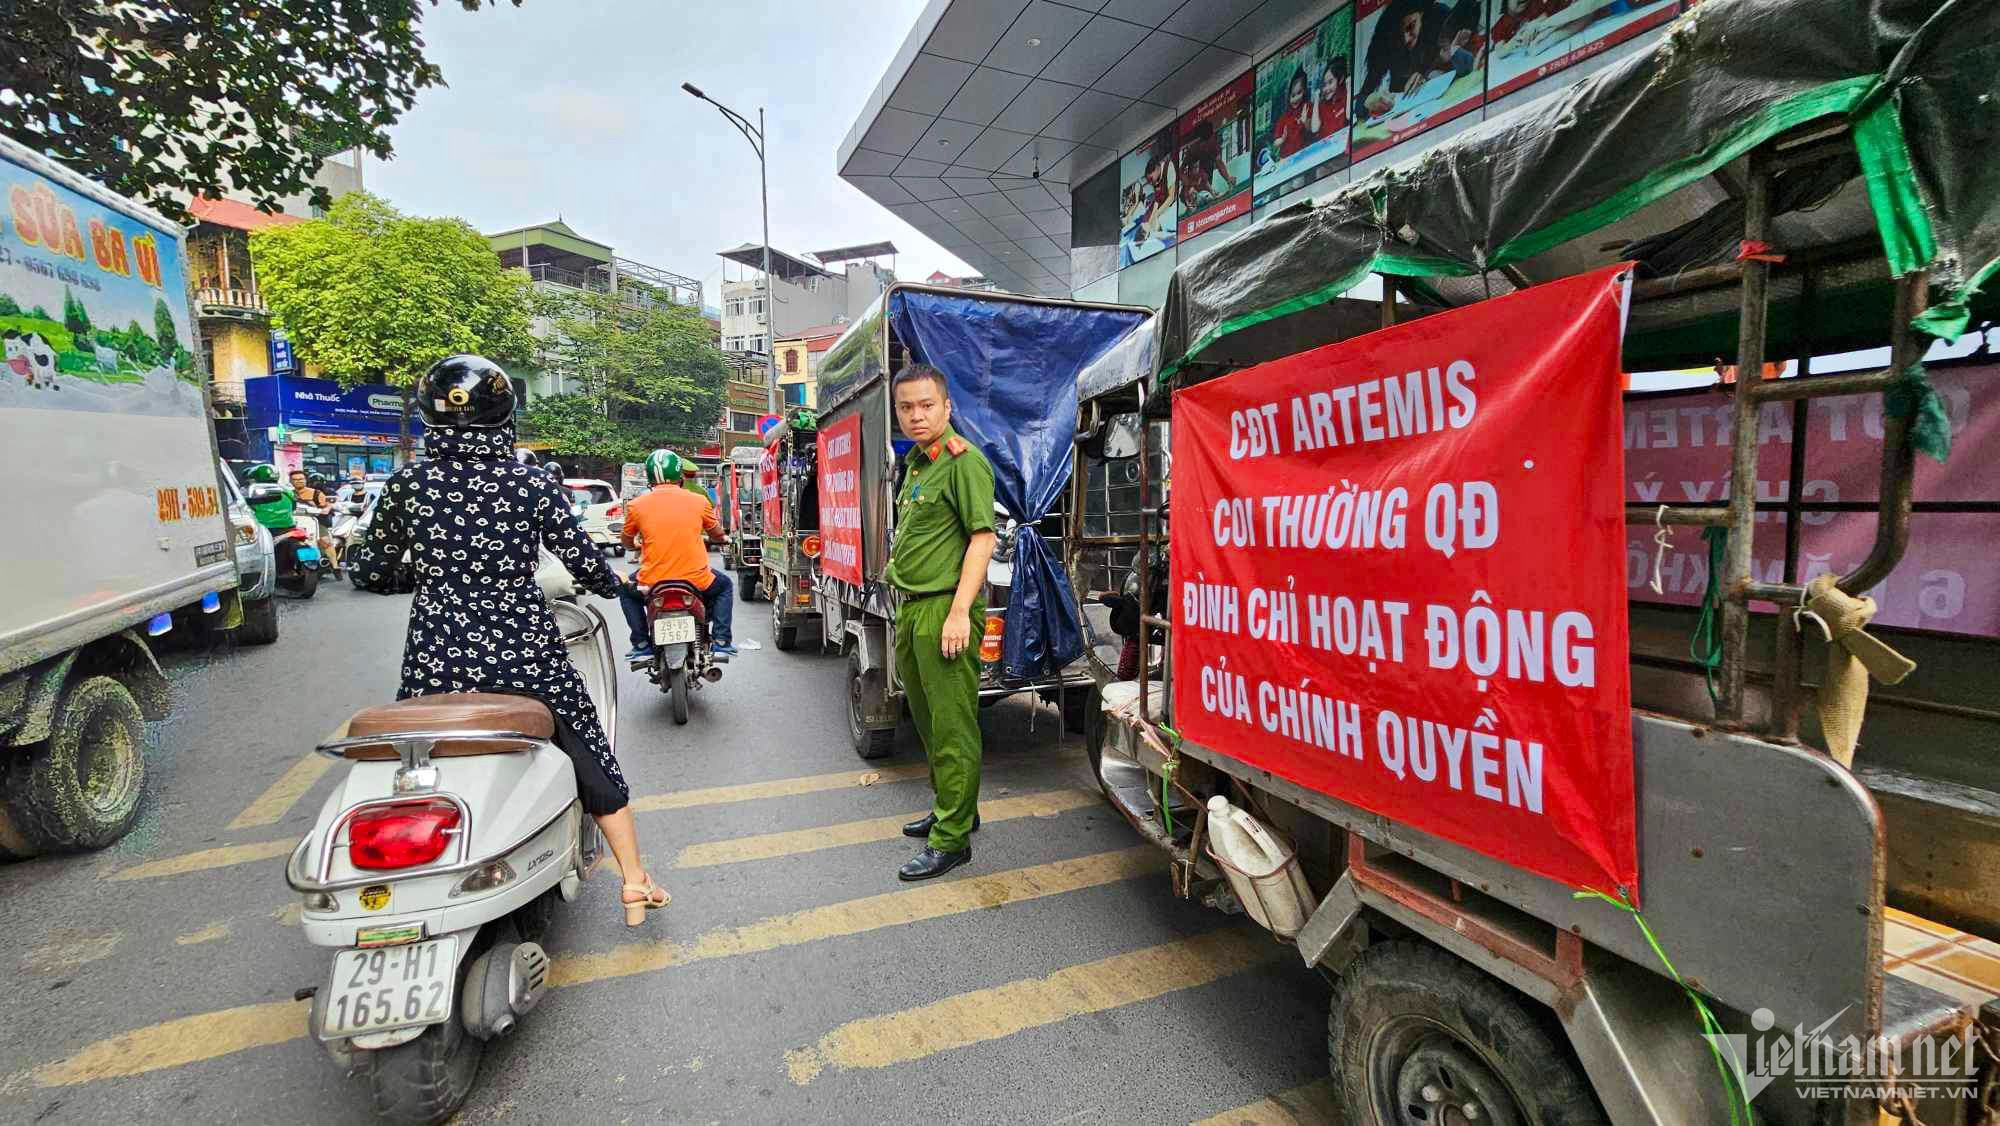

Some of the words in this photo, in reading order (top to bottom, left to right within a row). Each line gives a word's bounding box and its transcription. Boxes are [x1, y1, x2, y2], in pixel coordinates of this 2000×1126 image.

[1230, 402, 1280, 460] CĐT
[1291, 360, 1477, 452] ARTEMIS
[1213, 495, 1256, 549] COI
[1261, 479, 1409, 550] THƯỜNG
[1424, 481, 1499, 559] QĐ
[1183, 574, 1239, 635] ĐÌNH
[1247, 576, 1299, 645] CHỈ
[1308, 594, 1409, 673] HOẠT
[1424, 589, 1595, 693] ĐỘNG
[1201, 655, 1253, 727] CỦA
[1258, 678, 1363, 761] CHÍNH
[1376, 707, 1543, 815] QUYỀN
[337, 981, 445, 1031] 165.62
[348, 943, 438, 989] 29-H1
